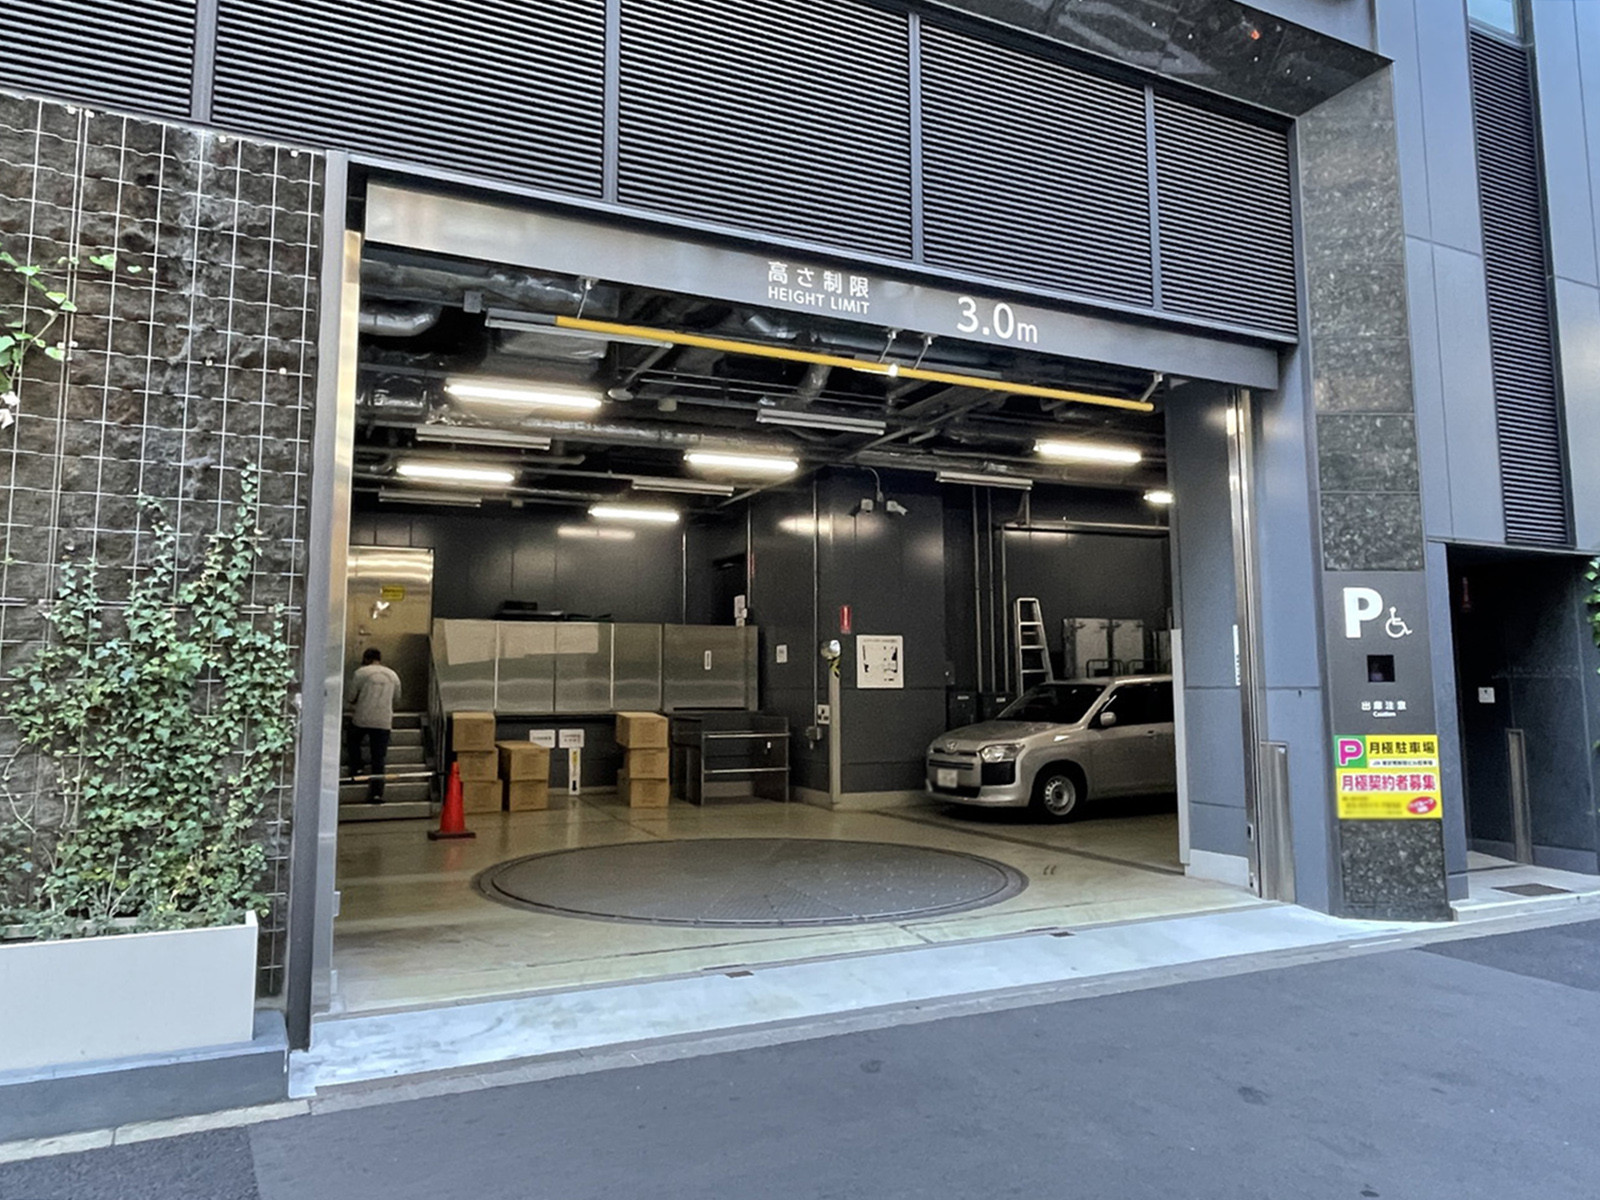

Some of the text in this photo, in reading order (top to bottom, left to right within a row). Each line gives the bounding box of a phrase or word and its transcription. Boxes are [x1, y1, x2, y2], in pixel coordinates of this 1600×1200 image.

[768, 261, 869, 298] 高さ制限
[768, 285, 870, 315] HEIGHT LIMIT
[957, 296, 1038, 343] 3.0m
[1343, 587, 1383, 638] P
[1338, 738, 1364, 766] P
[1369, 741, 1435, 755] 月極駐車場
[1342, 774, 1437, 792] 月極契約者募集
